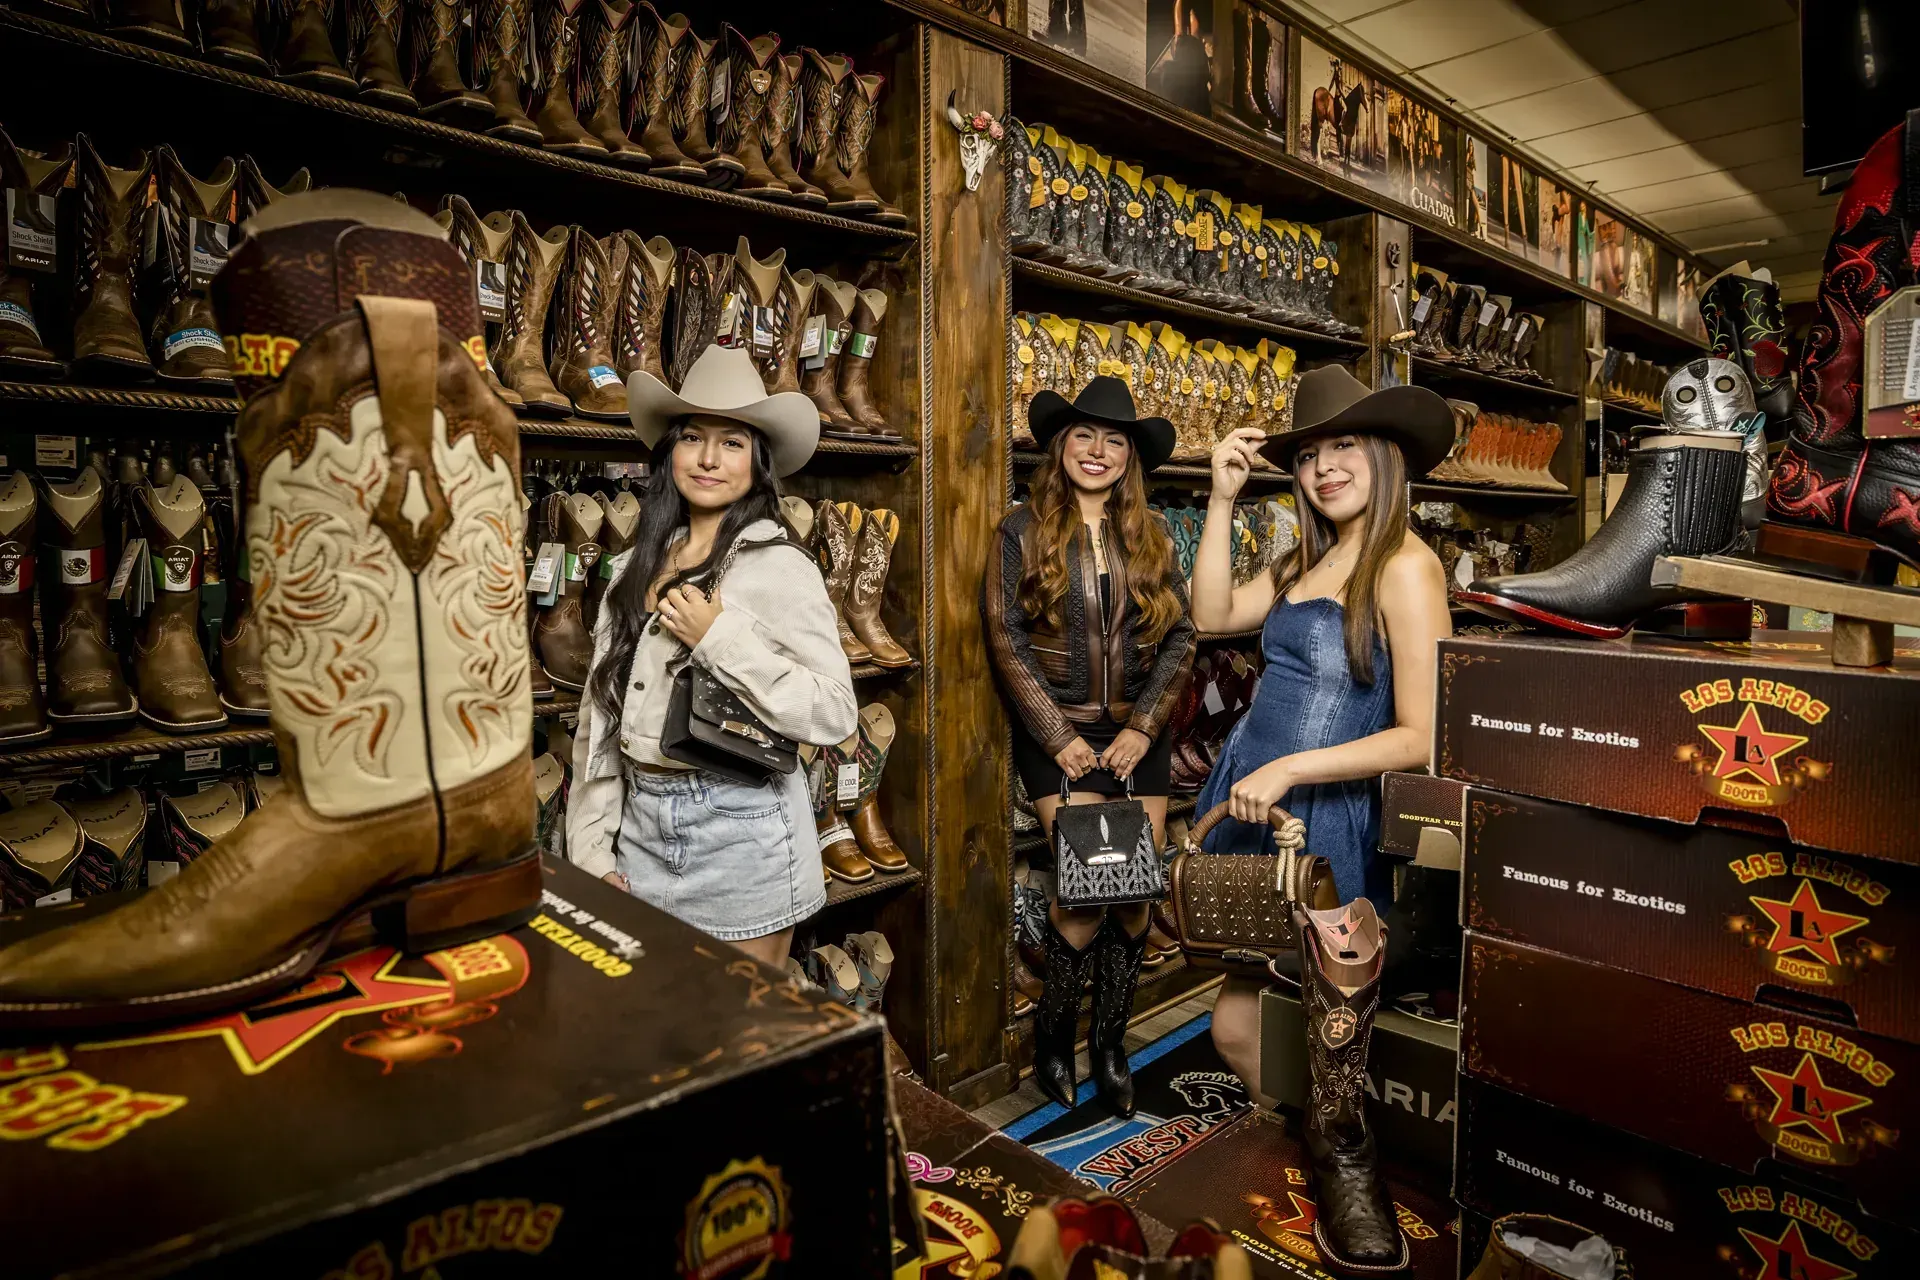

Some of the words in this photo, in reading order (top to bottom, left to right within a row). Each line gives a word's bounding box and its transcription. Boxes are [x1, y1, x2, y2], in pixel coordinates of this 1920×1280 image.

[1411, 186, 1456, 227] CUADRA
[12, 230, 32, 242] Shock
[33, 234, 53, 246] Shield
[24, 256, 50, 266] ARIAT
[193, 256, 208, 265] Shock
[181, 330, 203, 339] Shock
[1680, 679, 1735, 713] LOS
[1738, 678, 1830, 725] ALTOS
[1470, 714, 1532, 733] Famous
[1538, 723, 1564, 738] for
[1571, 727, 1639, 748] Exotics
[1721, 781, 1767, 802] BOOTS
[83, 800, 131, 823] ARIAT
[188, 797, 231, 820] ARIAT
[1399, 813, 1441, 824] GOODYEAR
[9, 815, 59, 844] ARIAT
[1503, 865, 1569, 890] Famous
[1576, 881, 1604, 897] for
[1612, 887, 1686, 915] Exotics
[1728, 852, 1787, 884] LOS
[1792, 852, 1891, 906] ALTOS
[1776, 956, 1828, 981] BOOTS
[1730, 1022, 1790, 1052] LOS
[1795, 1025, 1895, 1087] ALTOS
[1082, 1118, 1202, 1177] WEST
[1777, 1129, 1830, 1159] BOOTS
[1496, 1149, 1560, 1185] Famous
[1568, 1179, 1595, 1200] for
[1602, 1192, 1675, 1232] Exotics
[402, 1198, 566, 1273] ALTOS
[925, 1201, 985, 1240] BOOTS
[1717, 1185, 1776, 1213] LOS
[1780, 1191, 1880, 1261] ALTOS
[1231, 1229, 1308, 1270] GOODYEAR
[1241, 1242, 1275, 1262] Famous
[1277, 1260, 1293, 1270] for
